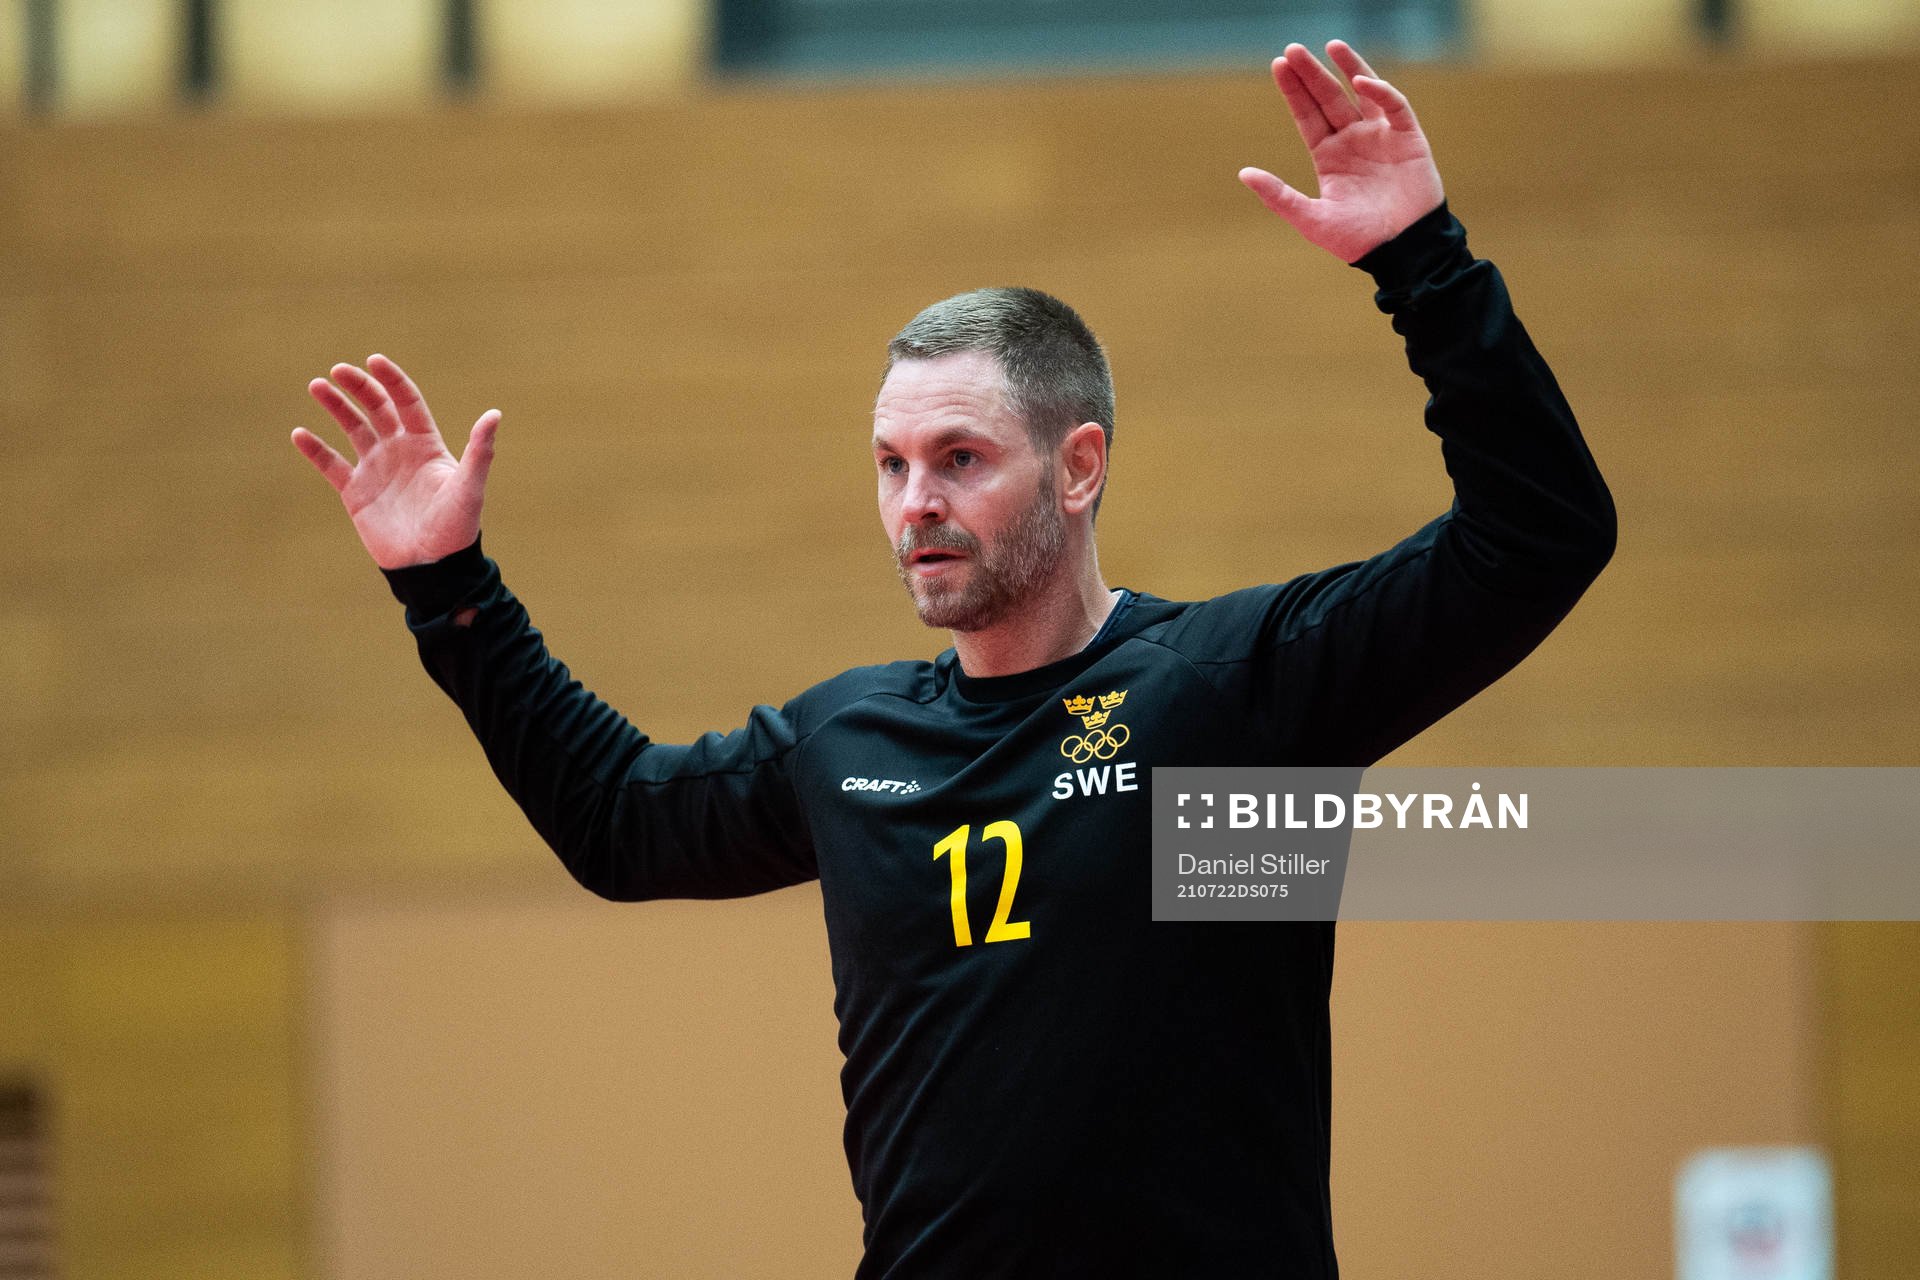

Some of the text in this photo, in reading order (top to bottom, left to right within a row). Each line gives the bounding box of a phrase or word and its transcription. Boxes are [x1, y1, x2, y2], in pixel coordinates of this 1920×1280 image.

[841, 776, 906, 794] CRAFT
[1052, 762, 1139, 800] SWE
[933, 820, 1031, 947] 12
